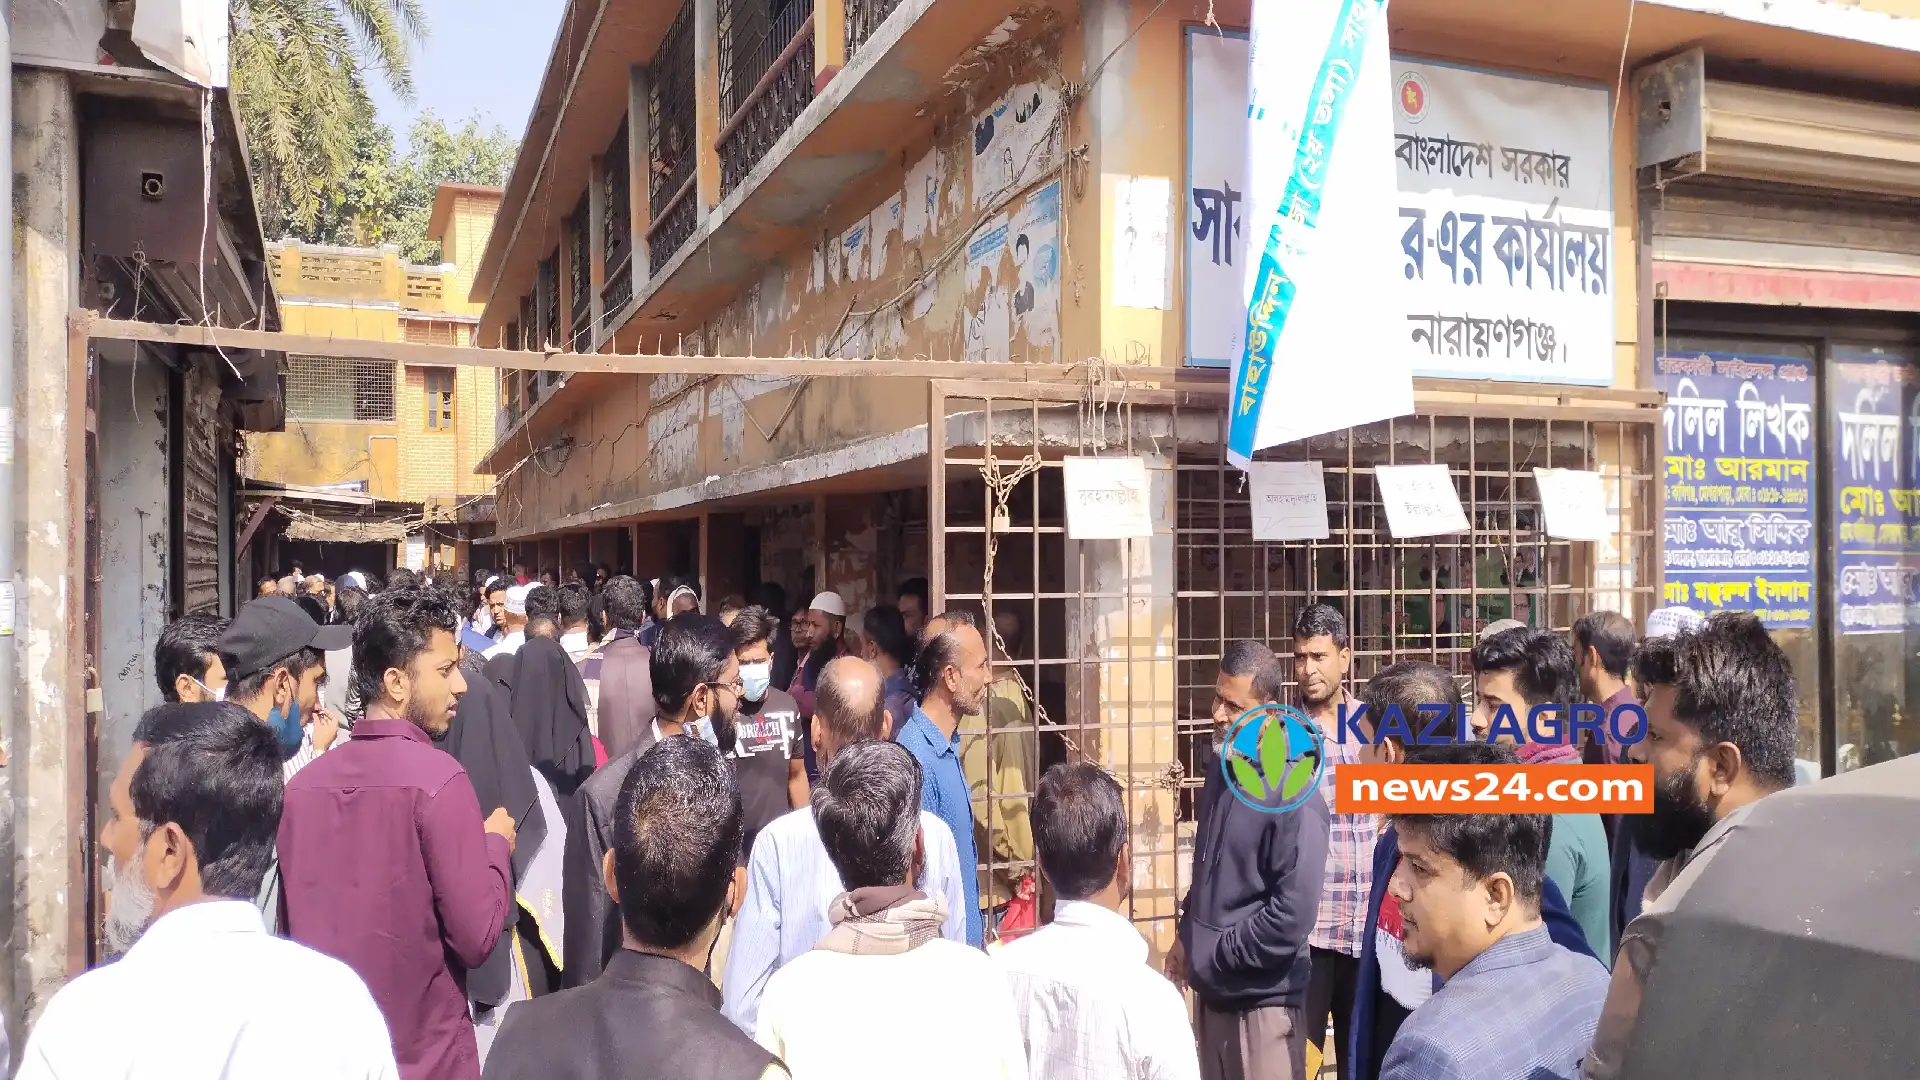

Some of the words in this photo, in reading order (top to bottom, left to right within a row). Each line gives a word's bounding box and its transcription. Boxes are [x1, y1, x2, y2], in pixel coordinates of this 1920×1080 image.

[1394, 130, 1494, 179] বাংলাদেশ
[1500, 146, 1572, 188] সরকার
[1192, 180, 1241, 266] সা
[1492, 197, 1610, 296] কার্যালয়
[1735, 380, 1811, 455] লিখক
[1714, 456, 1811, 482] আরমান
[1840, 484, 1885, 517] মোঃ
